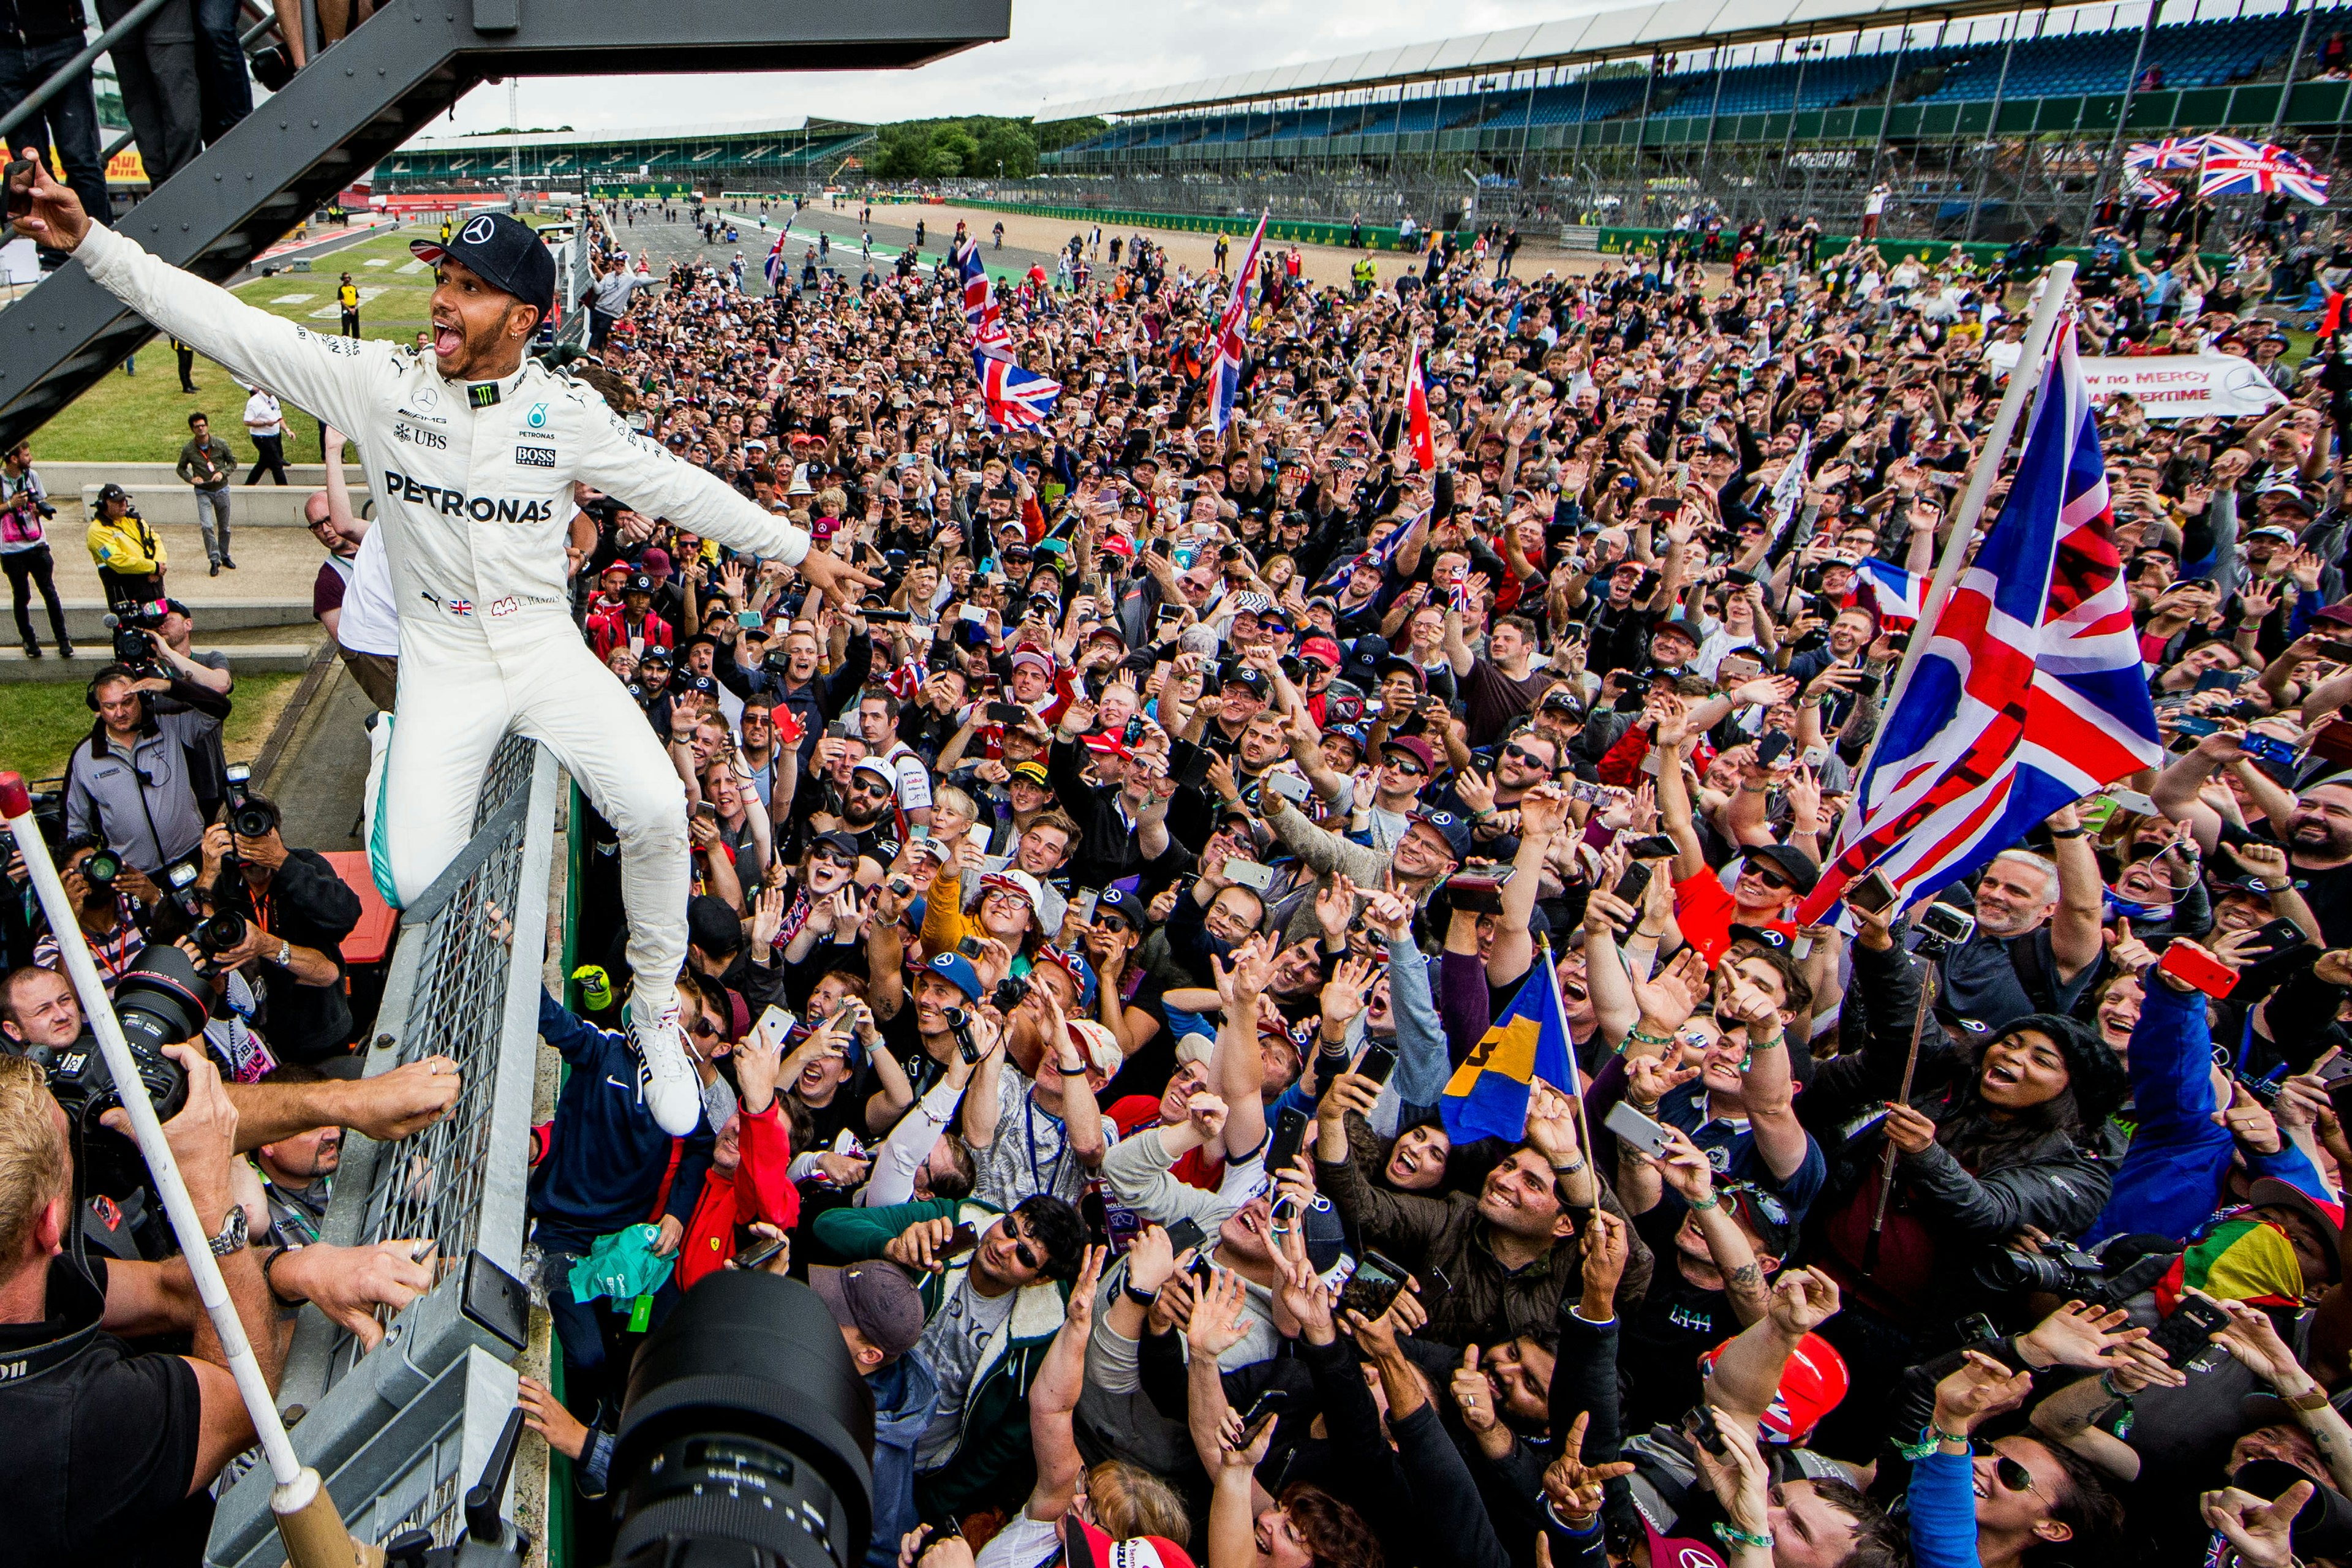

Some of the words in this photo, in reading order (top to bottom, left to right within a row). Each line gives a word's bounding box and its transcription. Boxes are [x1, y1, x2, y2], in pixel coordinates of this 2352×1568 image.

[391, 143, 820, 173] LVERSTONE
[413, 412, 447, 424] AMG
[415, 429, 447, 450] UBS
[519, 431, 555, 440] PETRONAS
[517, 447, 554, 462] BOSS
[385, 470, 554, 525] PETRONAS
[491, 595, 518, 616] 44
[1669, 1303, 1712, 1332] LH44
[1630, 1490, 1667, 1536] TRONAS
